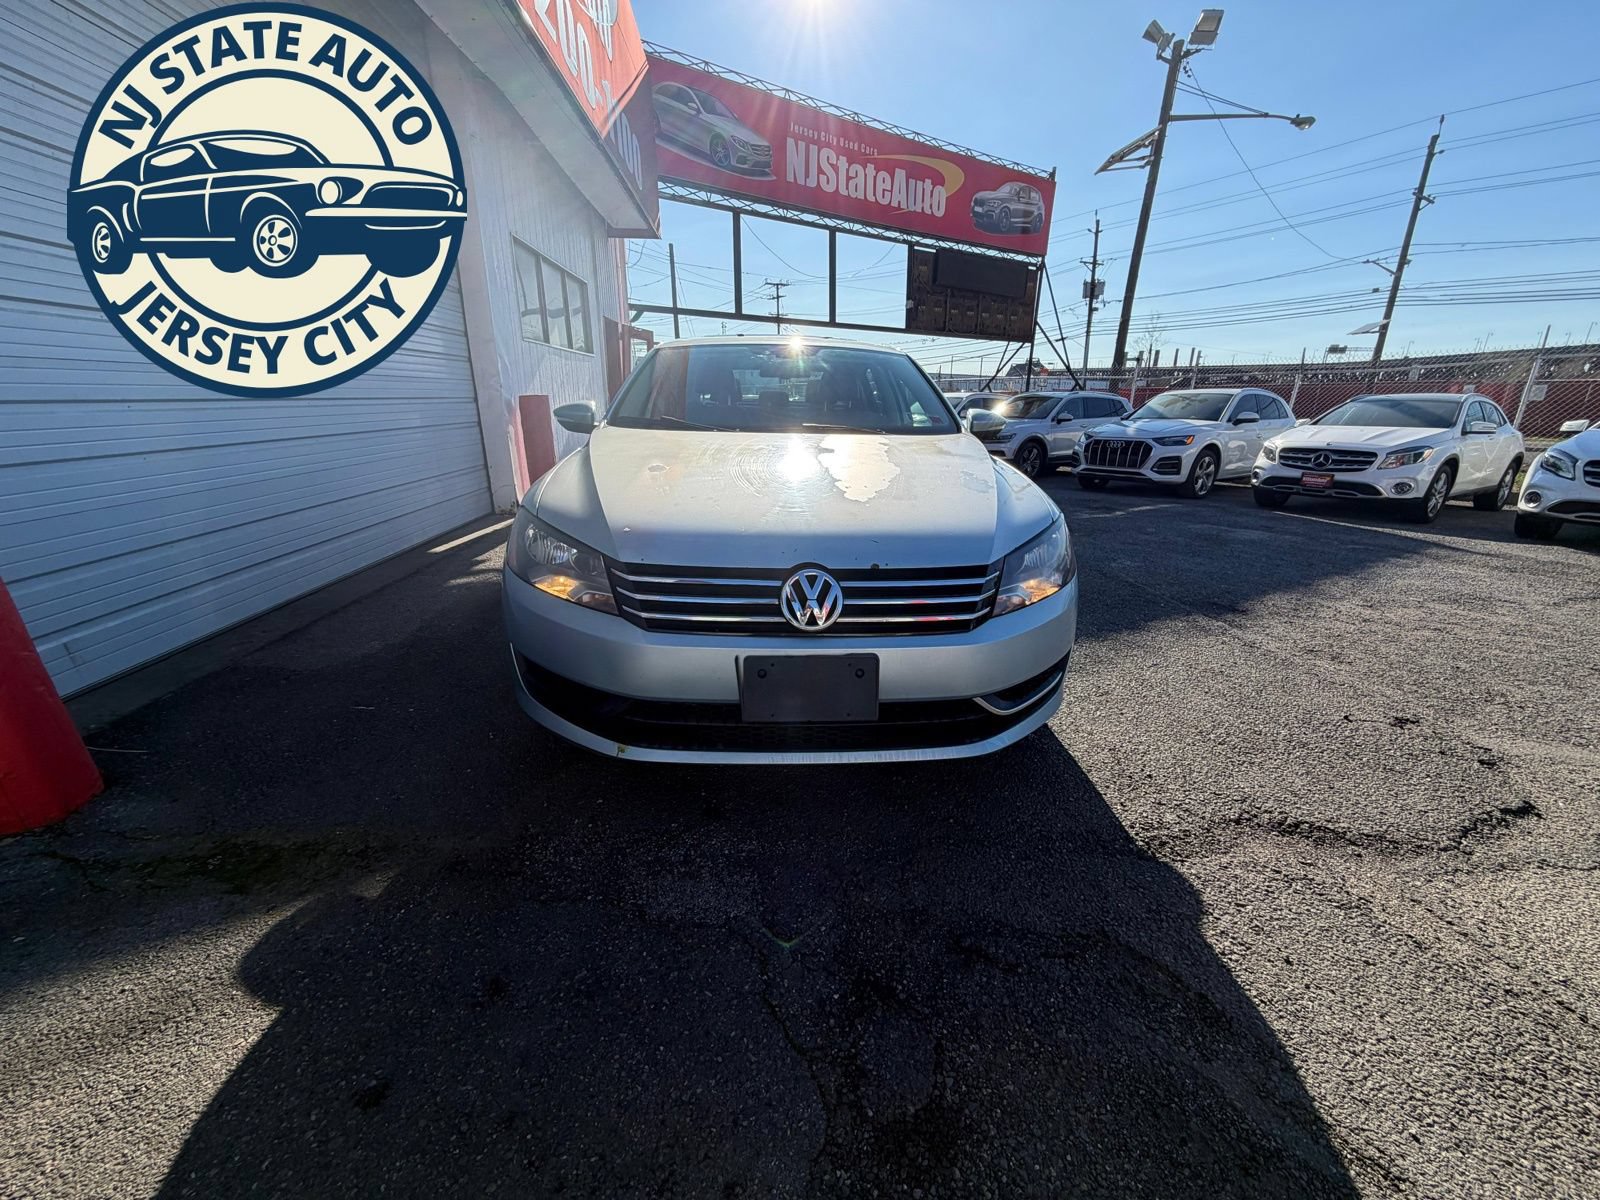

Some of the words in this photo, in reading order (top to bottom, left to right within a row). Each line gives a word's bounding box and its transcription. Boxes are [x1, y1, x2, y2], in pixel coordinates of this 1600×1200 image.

[790, 121, 818, 140] Jersey
[820, 131, 838, 146] City
[839, 136, 859, 151] Used
[861, 144, 878, 157] Cars
[786, 137, 945, 217] NJStateAuto
